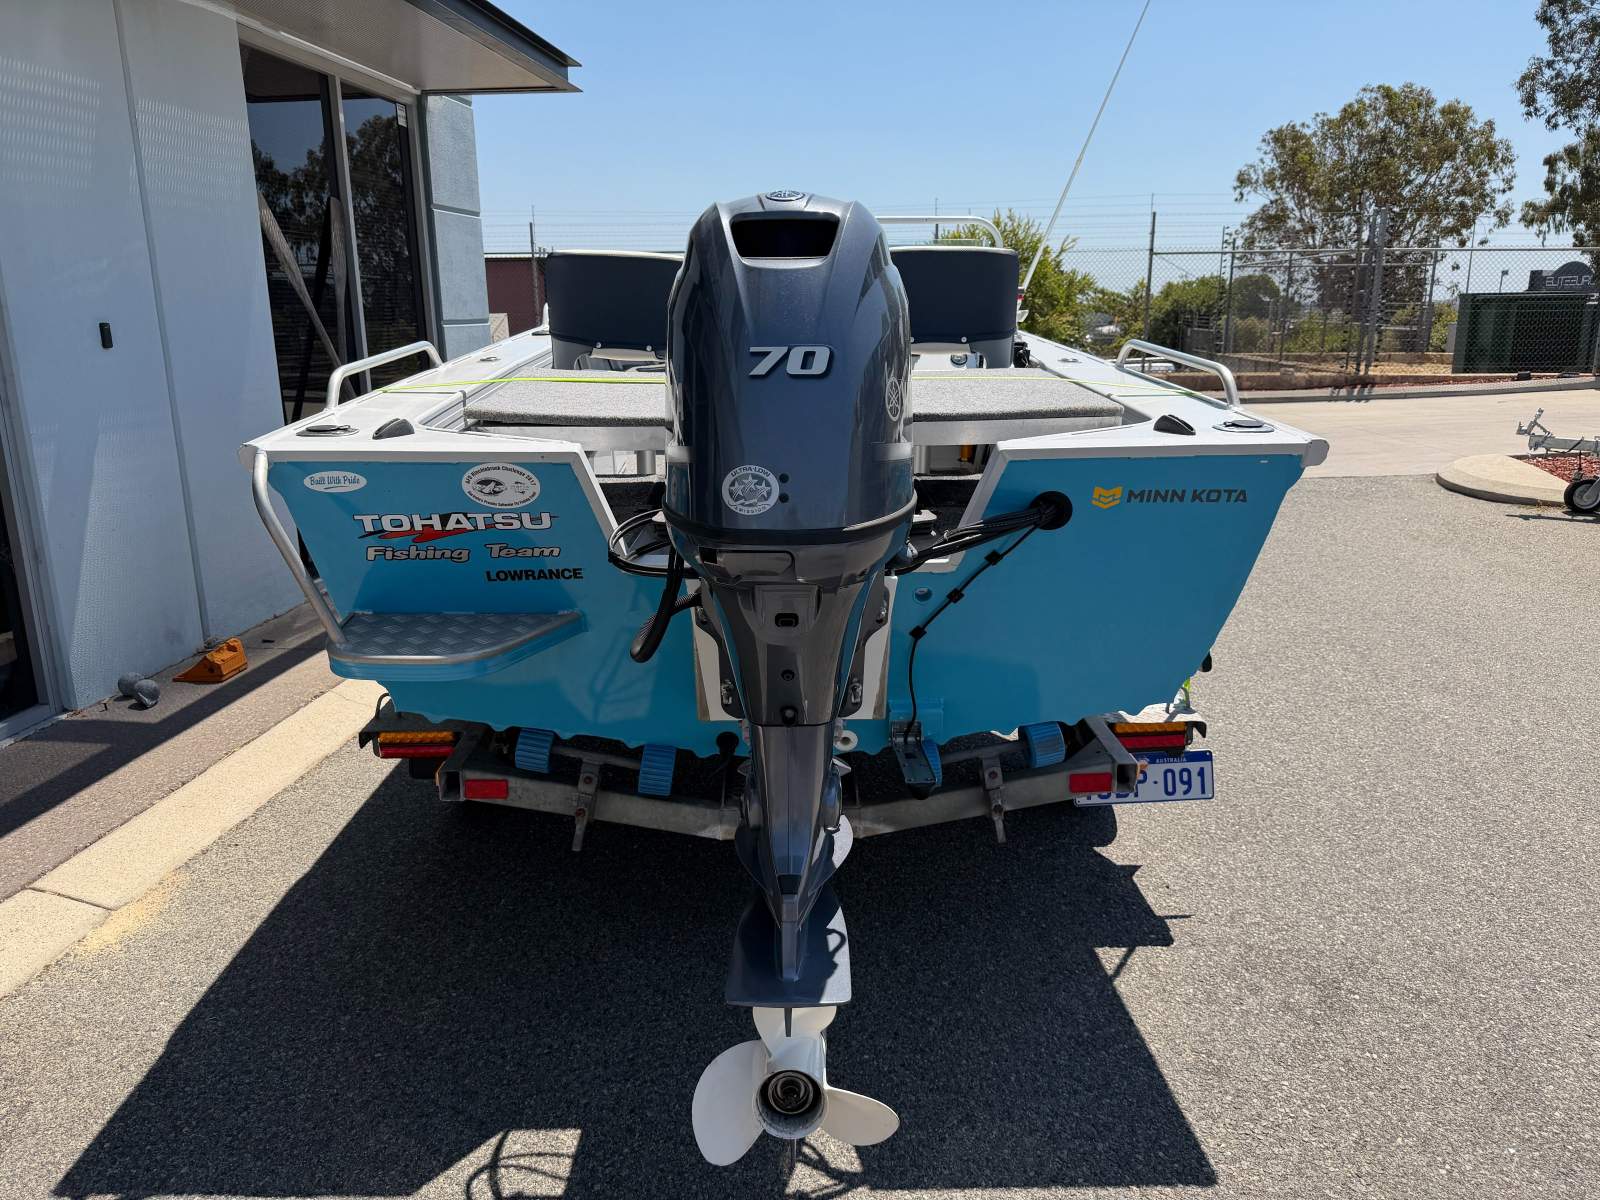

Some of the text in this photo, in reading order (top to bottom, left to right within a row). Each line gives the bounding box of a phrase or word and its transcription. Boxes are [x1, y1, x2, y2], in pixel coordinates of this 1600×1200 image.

[748, 346, 831, 376] 70
[327, 475, 341, 485] With
[343, 474, 360, 485] Pride
[1126, 488, 1248, 504] MINN KOTA
[353, 511, 552, 533] TOHATSU
[366, 543, 561, 563] Fishing Team
[486, 567, 584, 583] LOWRANCE
